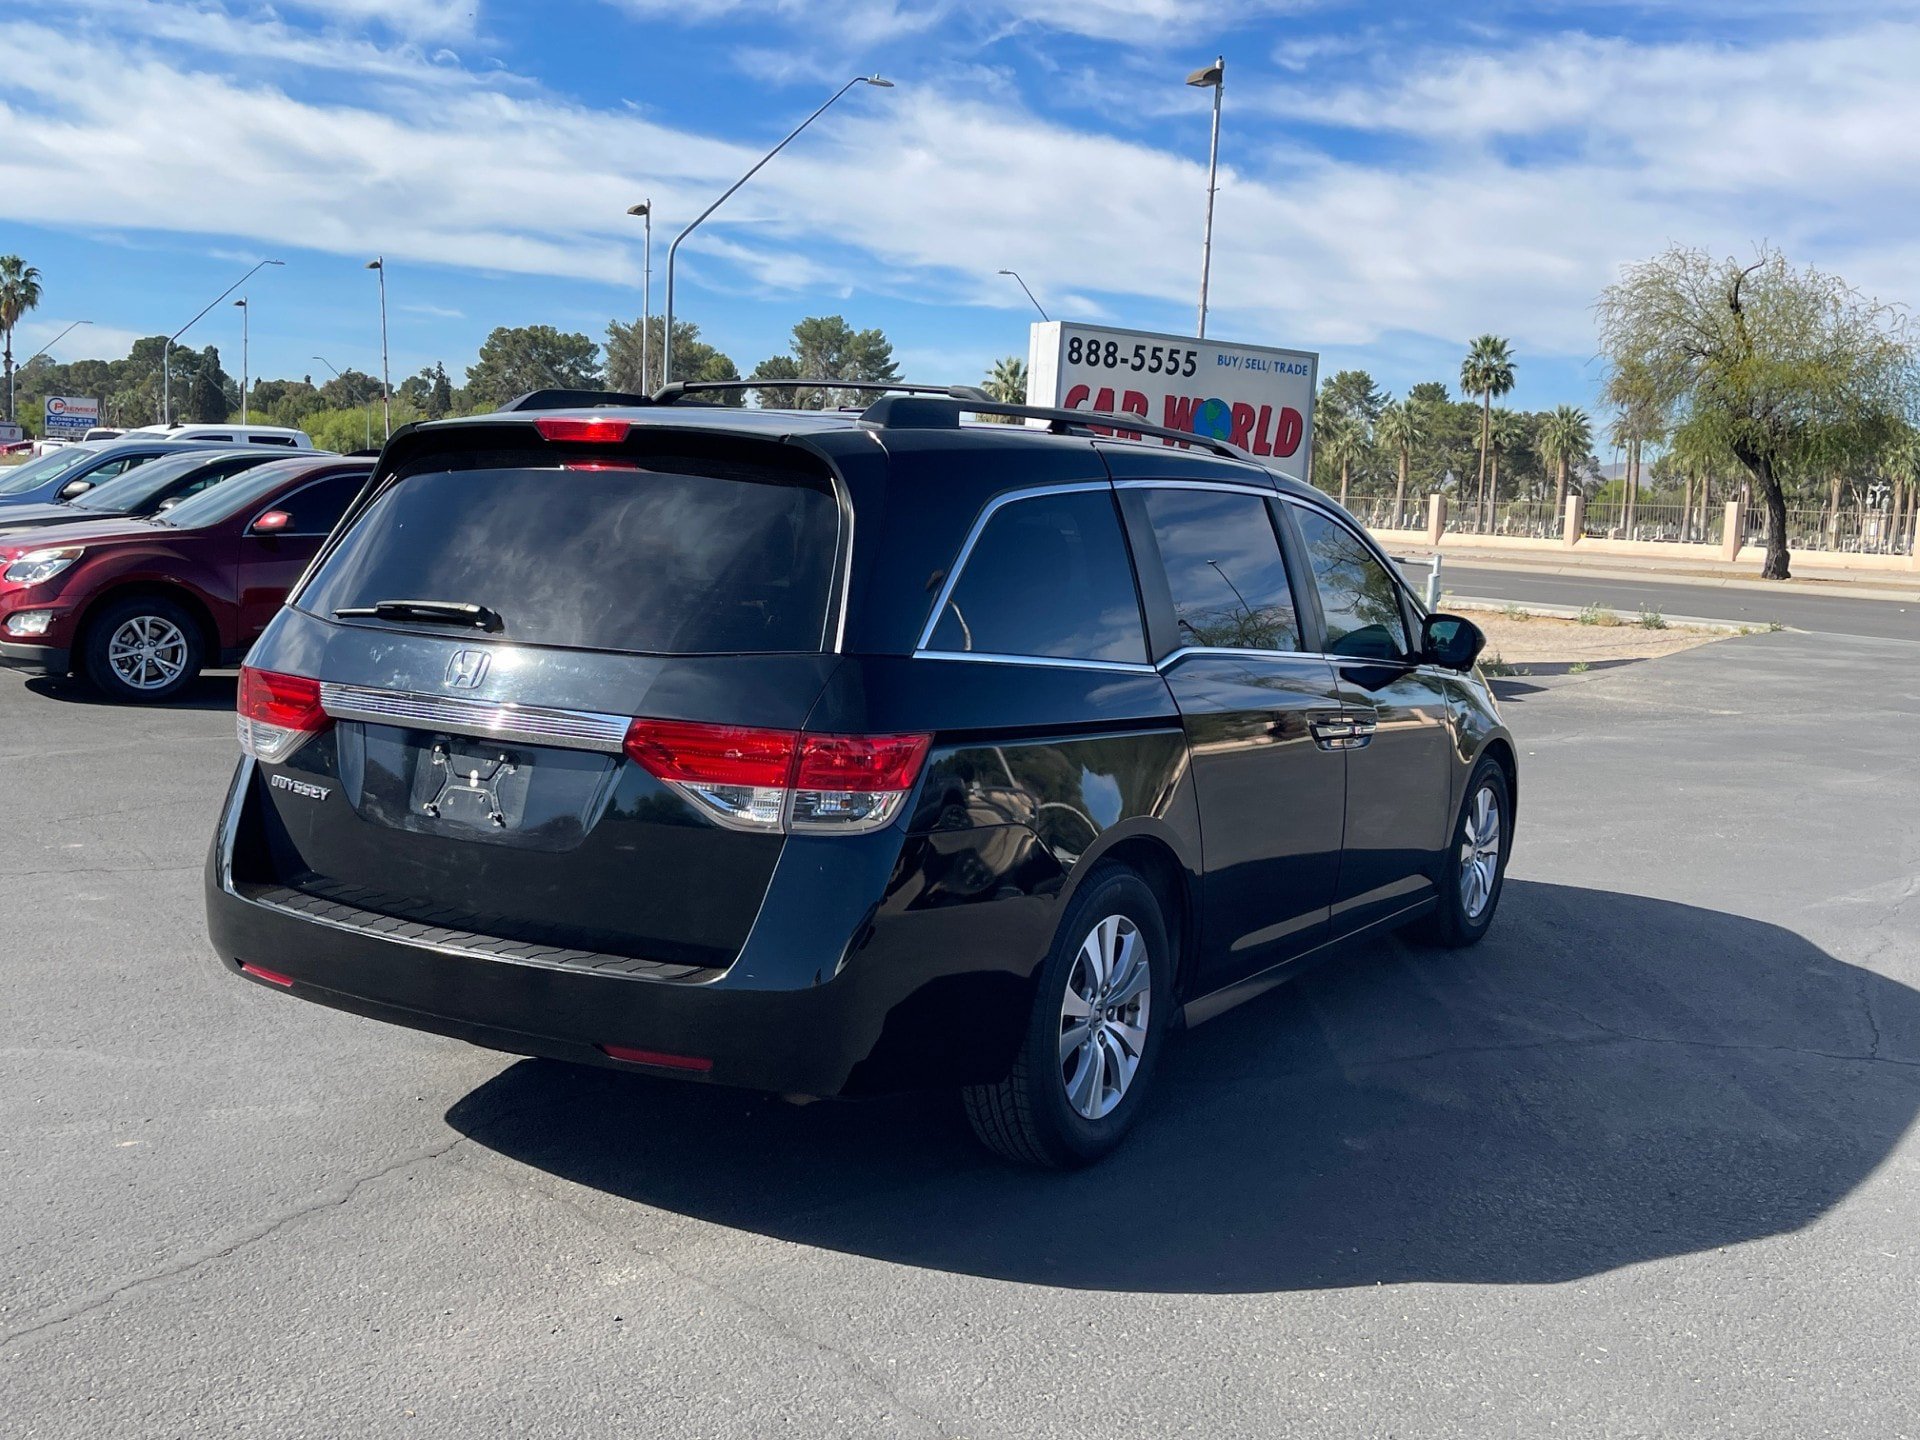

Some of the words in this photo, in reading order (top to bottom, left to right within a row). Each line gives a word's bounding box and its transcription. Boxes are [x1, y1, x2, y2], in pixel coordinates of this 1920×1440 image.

[1068, 336, 1198, 378] 888-5555
[50, 416, 93, 424] COMPLETE
[270, 774, 333, 801] ODYSSEY
